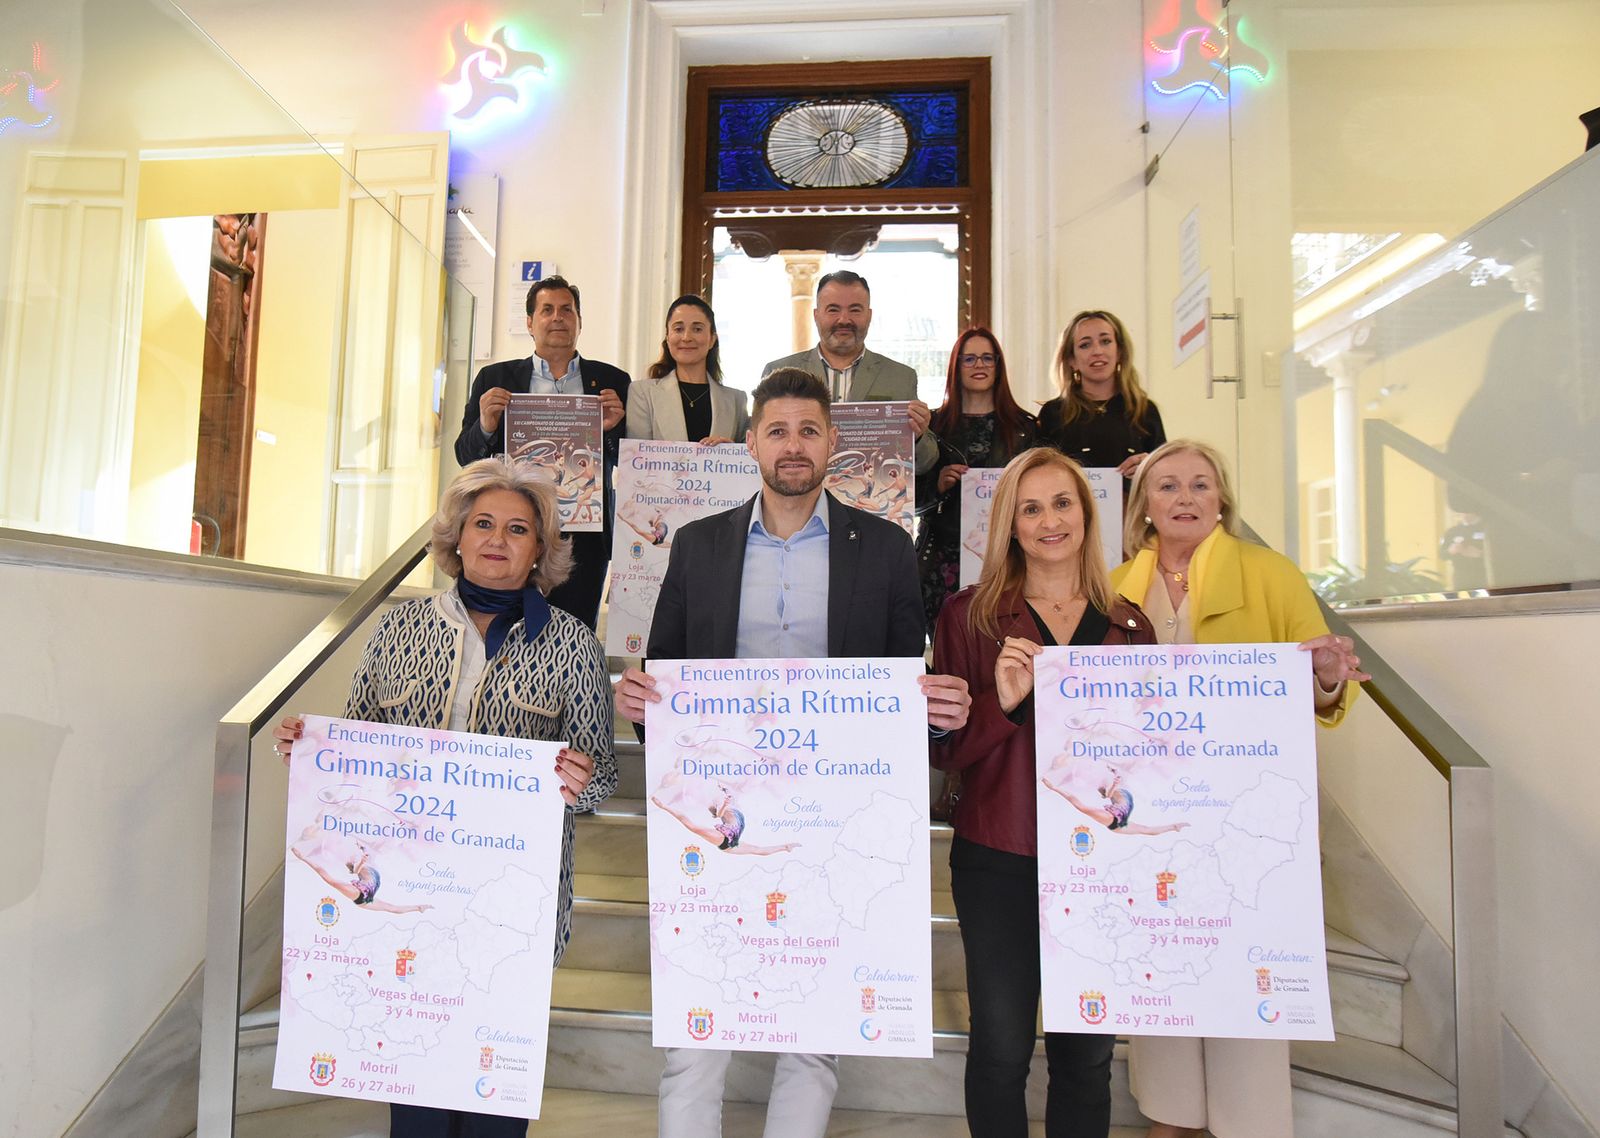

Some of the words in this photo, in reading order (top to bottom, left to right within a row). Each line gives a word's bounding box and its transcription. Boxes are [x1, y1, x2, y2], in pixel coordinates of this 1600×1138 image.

[638, 442, 693, 455] Encuentros
[696, 445, 751, 457] provinciale
[632, 456, 698, 473] Gimnasia
[704, 459, 758, 474] Rítmica
[676, 478, 712, 493] 2024
[636, 493, 689, 505] Diputación
[693, 495, 705, 505] de
[709, 497, 745, 507] Granad
[629, 563, 644, 571] Loja
[1069, 650, 1167, 666] Encuentros
[1174, 649, 1277, 669] provinciales
[681, 665, 779, 681] Encuentros
[786, 664, 890, 684] provinciales
[1060, 676, 1178, 699] Gimnasia
[1189, 674, 1287, 697] Rítmica
[671, 691, 790, 715] Gimnasia
[802, 690, 900, 713] Rítmica
[1142, 711, 1206, 734] 2024
[328, 723, 423, 749] Encuentros
[430, 739, 532, 760] provinciales
[754, 728, 819, 752] 2024
[1072, 740, 1168, 761] Diputación
[1175, 740, 1196, 757] de
[1203, 740, 1278, 757] Granada
[316, 749, 432, 782] Gimnasia
[444, 762, 540, 792] Rítmica
[683, 758, 779, 779] Diputación
[787, 759, 808, 776] de
[815, 759, 891, 776] Granada
[1172, 777, 1211, 794] Sedes
[394, 794, 457, 821] 2024
[784, 797, 822, 813] Sedes
[324, 815, 417, 839] Diputación
[424, 826, 444, 843] de
[452, 829, 525, 850] Granada
[419, 861, 456, 879] Sedes
[1070, 865, 1096, 877] Loja
[680, 884, 706, 897] Loja
[1042, 883, 1056, 892] 22
[1060, 885, 1067, 896] y
[1071, 883, 1084, 892] 23
[1089, 885, 1129, 893] marzo
[652, 903, 666, 912] 22
[670, 905, 677, 915] y
[681, 903, 694, 912] 23
[699, 904, 738, 913] marzo
[1132, 916, 1170, 928] Vegas
[1175, 916, 1193, 927] del
[1198, 917, 1231, 928] Genil
[314, 934, 339, 946] Loja
[742, 936, 778, 948] Vegas
[783, 936, 802, 947] del
[806, 936, 839, 948] Genil
[1150, 934, 1157, 944] 3
[1160, 937, 1168, 947] y
[1172, 935, 1179, 944] 4
[1183, 937, 1219, 948] mayo
[286, 948, 299, 958] 22
[304, 951, 310, 961] y
[314, 950, 327, 961] 23
[332, 954, 369, 966] marzo
[759, 954, 765, 964] 3
[769, 956, 776, 966] y
[780, 954, 787, 964] 4
[792, 956, 826, 967] mayo
[370, 988, 406, 1000] Vegas
[410, 990, 429, 1002] del
[433, 994, 464, 1007] Genil
[1132, 995, 1171, 1007] Motril
[385, 1006, 392, 1016] 3
[396, 1009, 402, 1018] y
[406, 1008, 413, 1018] 4
[417, 1010, 450, 1022] mayo
[738, 1012, 777, 1024] Motril
[1116, 1014, 1130, 1024] 26
[1133, 1017, 1140, 1028] y
[1144, 1015, 1159, 1025] 27
[1164, 1014, 1194, 1026] abril
[721, 1030, 736, 1040] 26
[739, 1033, 746, 1044] y
[750, 1031, 764, 1041] 27
[768, 1031, 798, 1043] abril
[360, 1061, 398, 1074] Motril
[341, 1078, 355, 1088] 26
[359, 1081, 365, 1092] y
[369, 1080, 382, 1091] 27
[386, 1082, 414, 1096] abril
